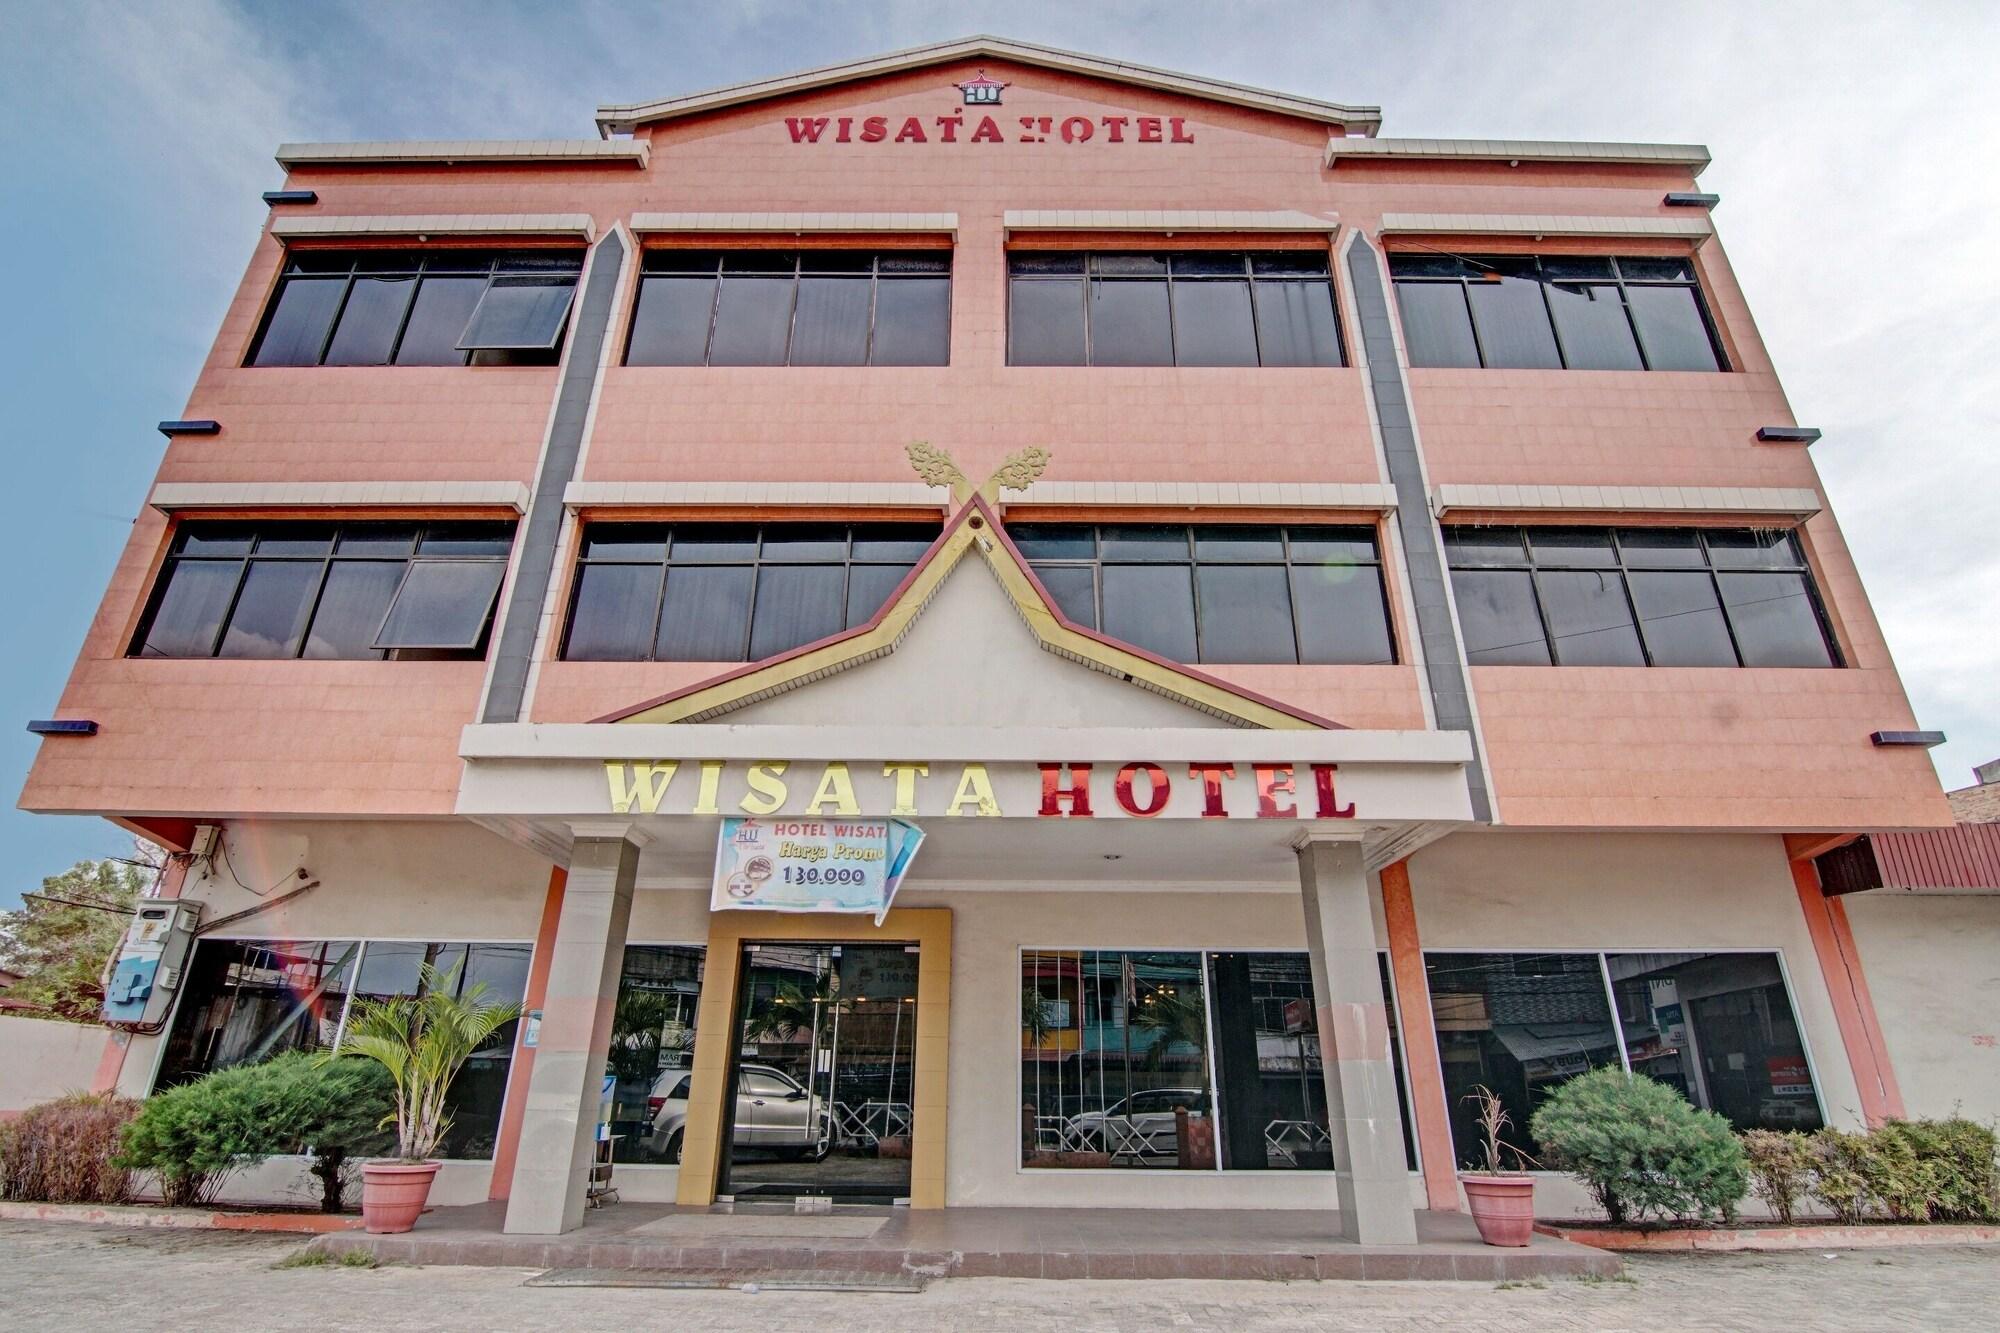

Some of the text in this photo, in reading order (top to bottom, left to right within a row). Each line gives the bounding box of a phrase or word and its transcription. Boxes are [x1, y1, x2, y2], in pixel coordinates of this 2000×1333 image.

[785, 115, 1004, 143] WISATA
[601, 759, 1356, 819] WISATA HOTEL
[774, 823, 827, 837] HOTEL
[778, 841, 828, 862] Harga
